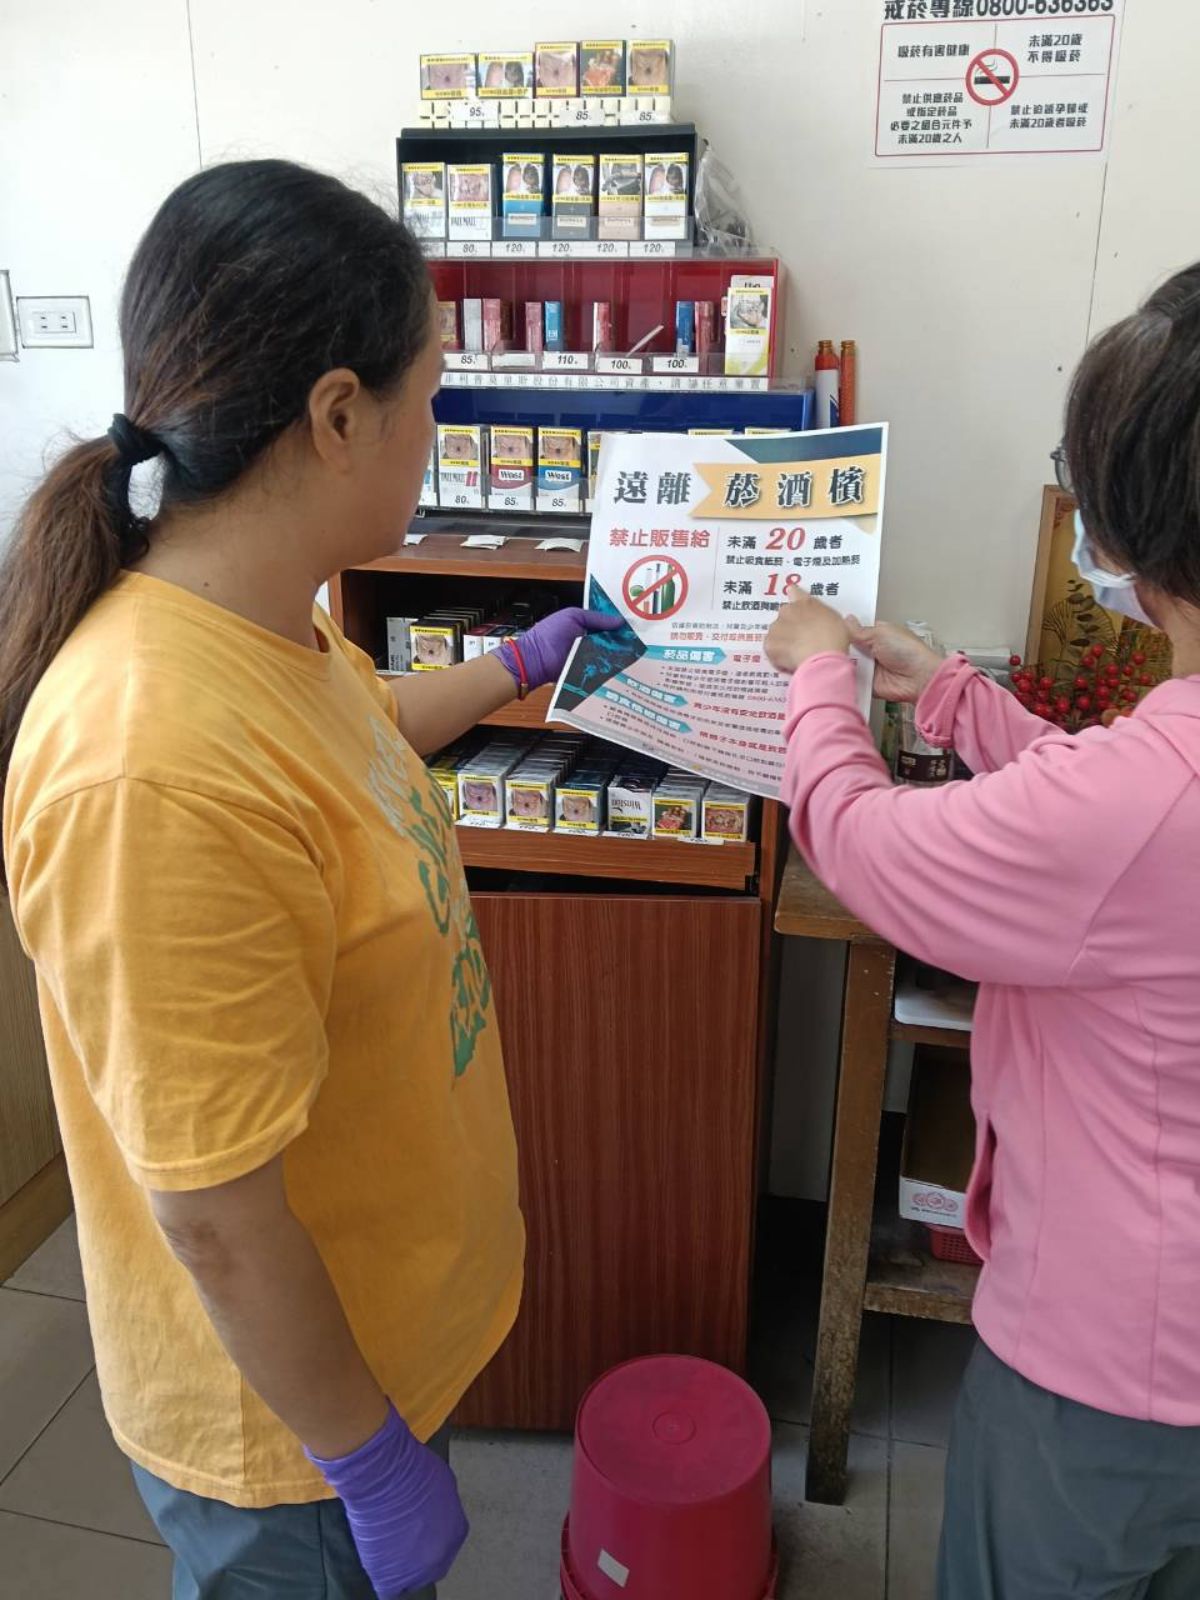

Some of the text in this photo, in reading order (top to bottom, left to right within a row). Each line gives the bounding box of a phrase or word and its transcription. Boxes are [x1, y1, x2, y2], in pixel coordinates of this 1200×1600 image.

[1028, 33, 1083, 47] 未滿20歲
[897, 43, 970, 58] 吸菸有害健康
[1027, 49, 1081, 63] 不得吸菸
[898, 132, 962, 144] 未滿20歲之人
[614, 470, 691, 505] 遠離
[609, 528, 711, 548] 禁止販售給
[727, 527, 843, 550] 未滿 20 歲者
[723, 580, 752, 595] 未滿
[810, 582, 840, 596] 歲者
